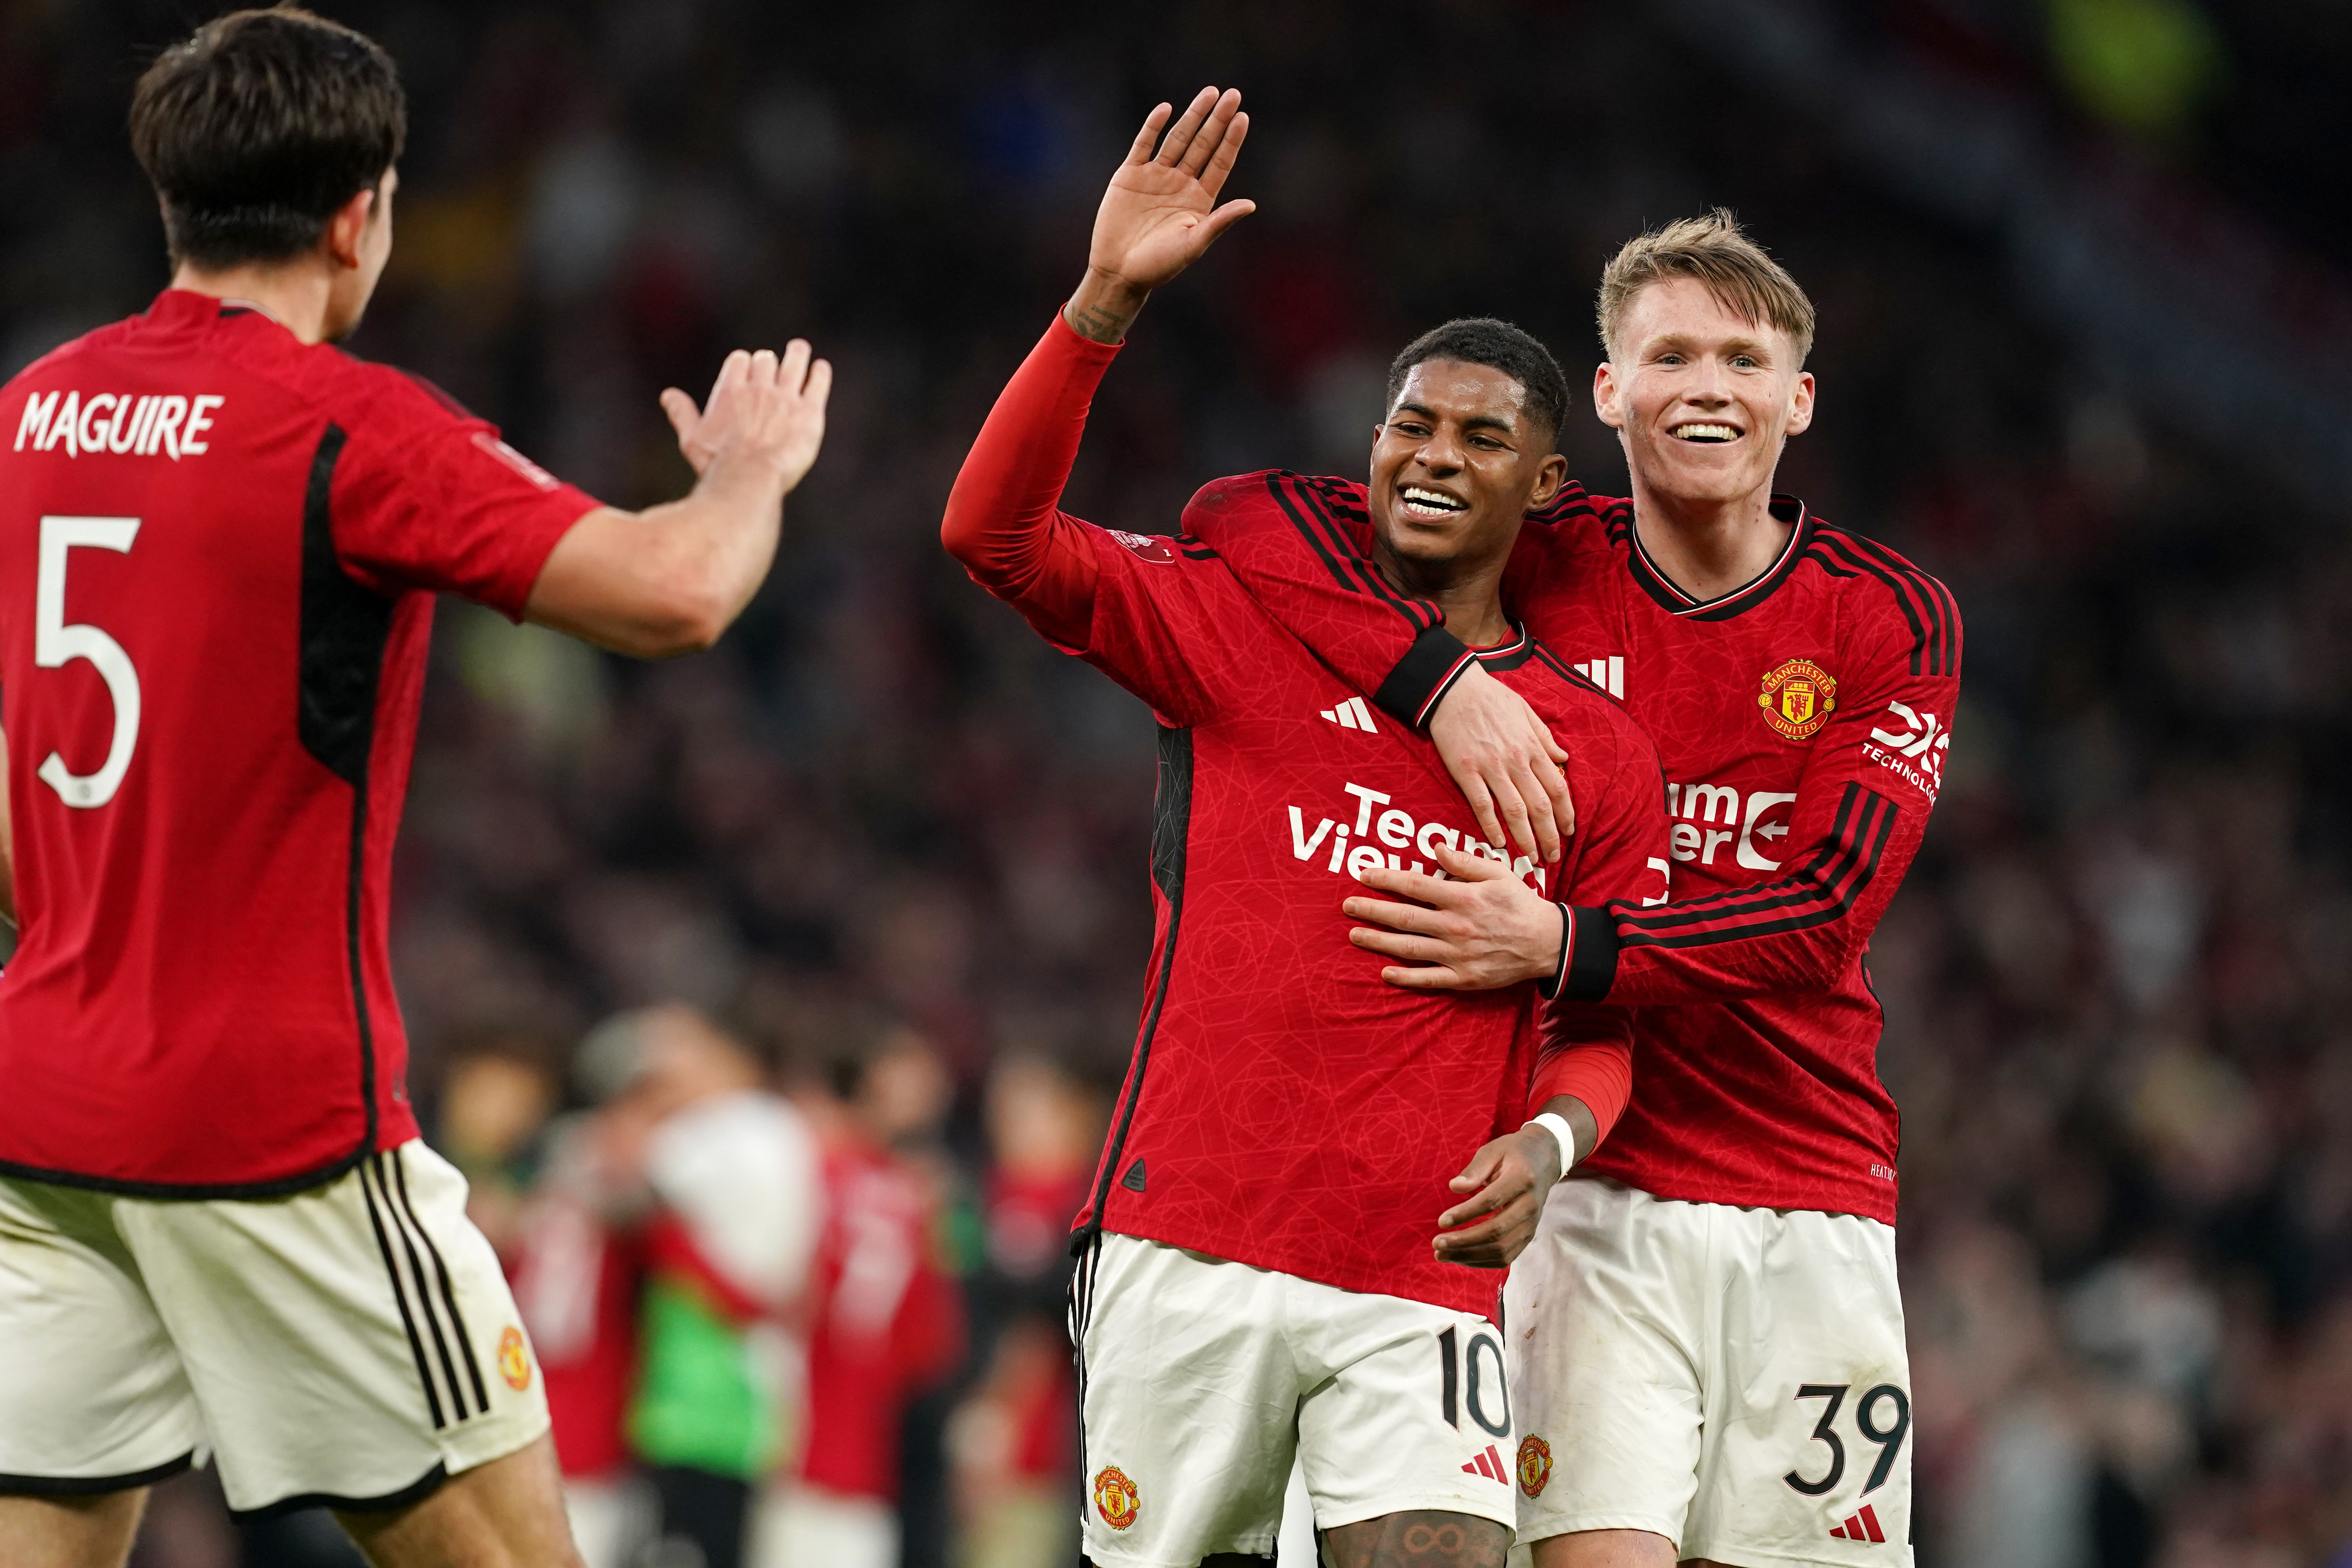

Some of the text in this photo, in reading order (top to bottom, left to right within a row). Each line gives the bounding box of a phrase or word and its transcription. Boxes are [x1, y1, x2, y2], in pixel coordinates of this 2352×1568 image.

[14, 391, 225, 461] MAGUIRE
[36, 516, 142, 809] 5
[1767, 665, 1831, 693] MANCHESTER
[1775, 719, 1817, 734] UNITED
[1437, 1323, 1511, 1439] 10
[1517, 1439, 1546, 1465] MANCHESTER
[1782, 1383, 1912, 1498] 39
[1098, 1471, 1133, 1494] MANCHESTER
[1525, 1479, 1544, 1494] UNITED
[1105, 1513, 1130, 1526] UNITED
